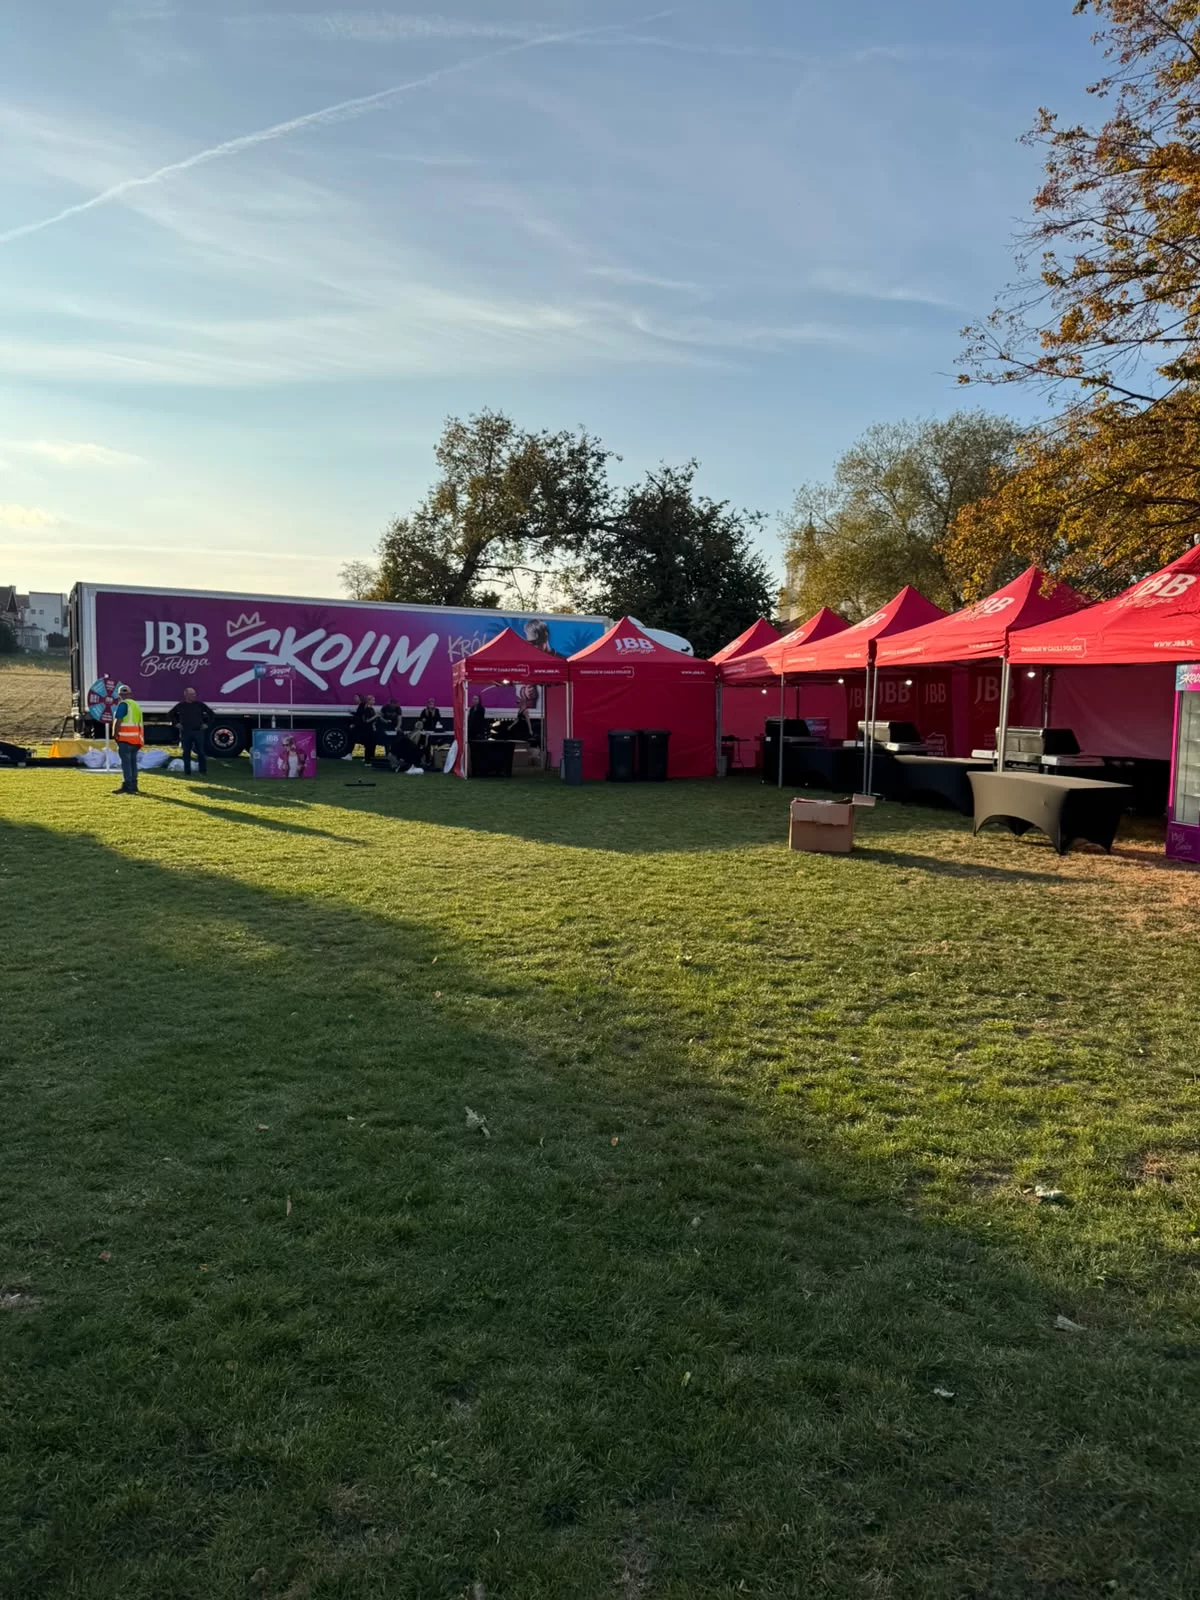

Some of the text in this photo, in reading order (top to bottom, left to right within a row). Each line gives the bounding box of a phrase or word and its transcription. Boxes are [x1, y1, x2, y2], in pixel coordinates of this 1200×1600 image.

[141, 621, 209, 657] JBB
[615, 637, 654, 651] JBB
[220, 627, 439, 694] SKOLIM
[925, 683, 946, 704] JBB
